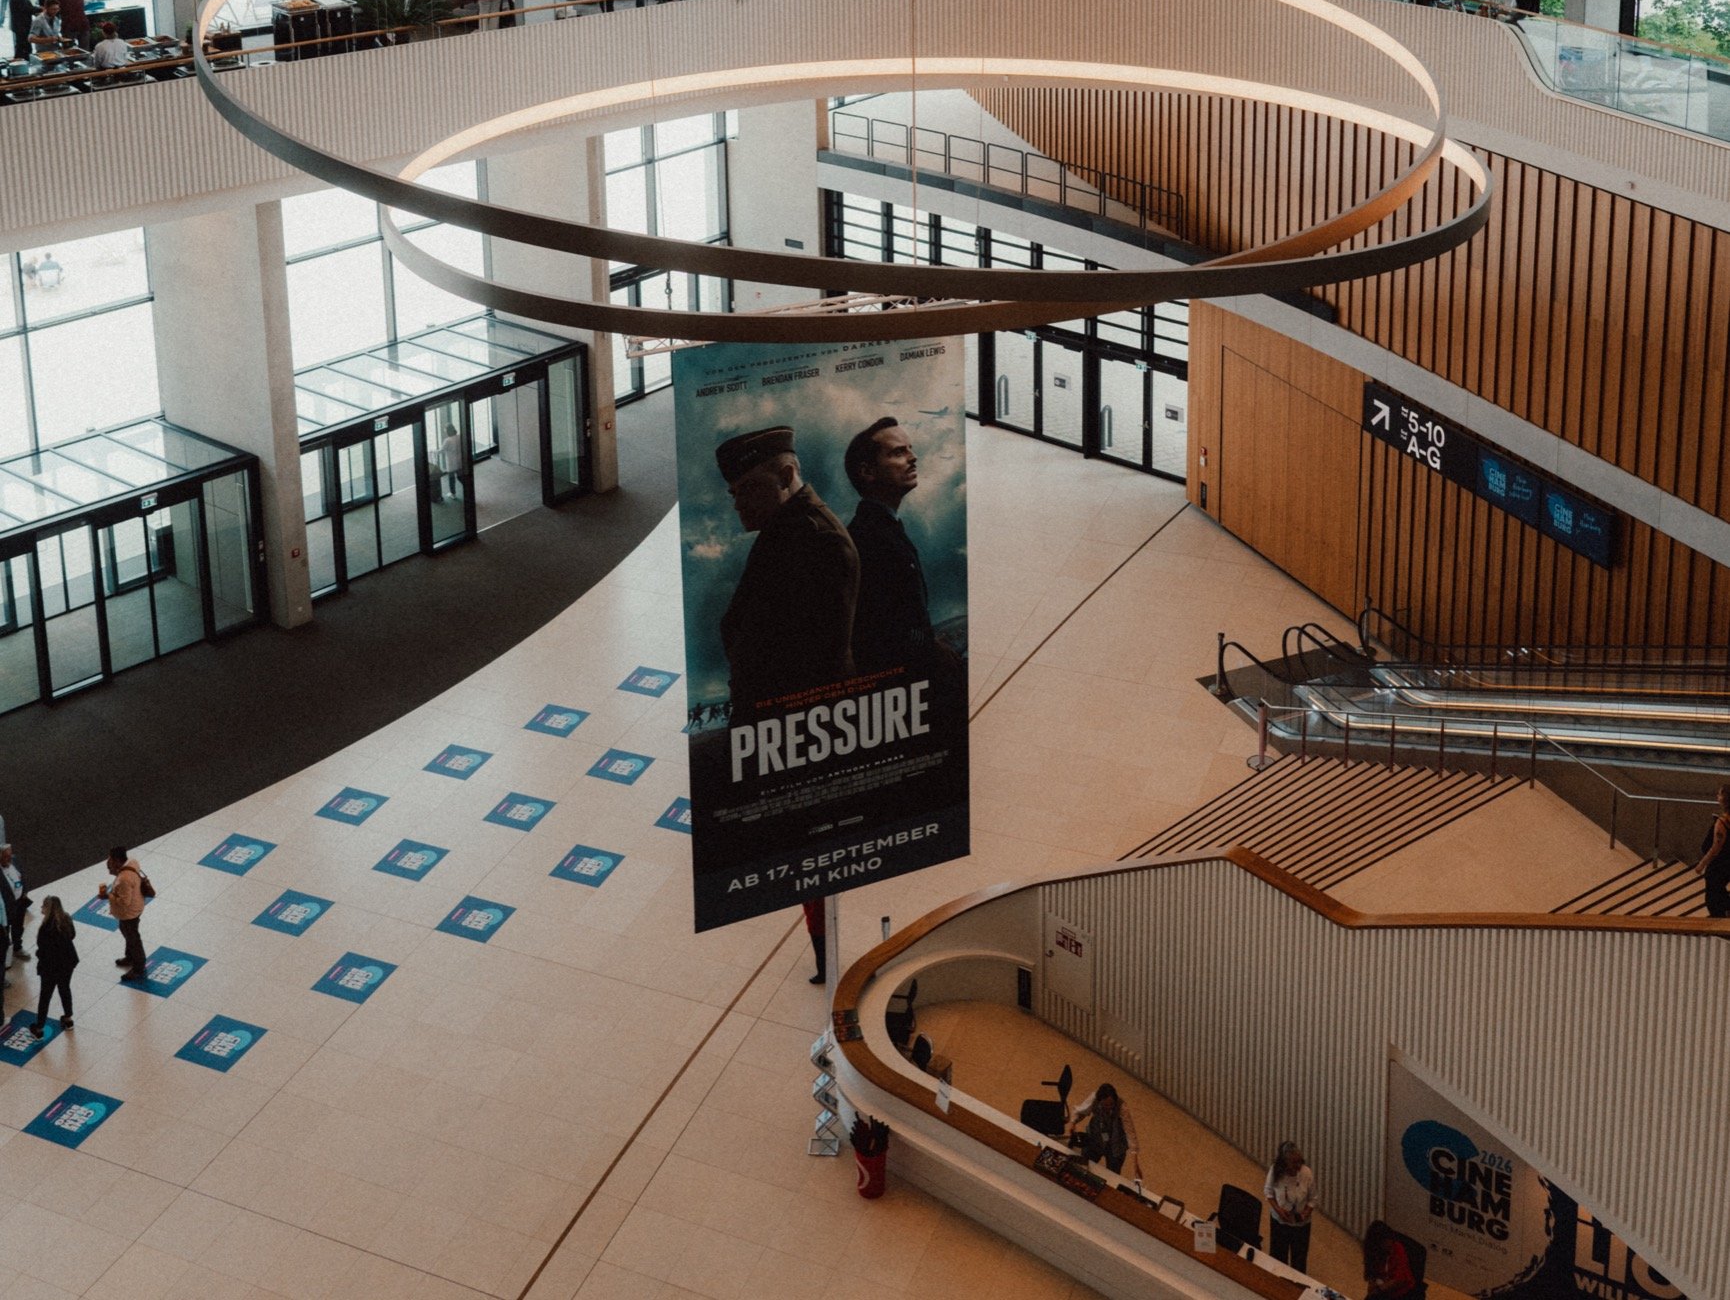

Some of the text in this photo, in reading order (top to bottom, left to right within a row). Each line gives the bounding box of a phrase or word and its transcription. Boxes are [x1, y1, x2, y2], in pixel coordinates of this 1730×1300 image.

[835, 361, 856, 373] KERRY
[857, 356, 884, 369] CONDON
[900, 350, 925, 362] DAMIAN
[925, 345, 946, 357] LEWIS
[696, 383, 725, 398] ANDREW
[726, 380, 748, 393] SCOTT
[761, 374, 793, 387] BRENDAN
[793, 368, 820, 380] FRASER
[1408, 411, 1445, 448] 5-10
[1407, 435, 1441, 470] A-G
[731, 680, 930, 783] PRESSURE
[727, 873, 760, 893] AB
[766, 864, 794, 881] 17.
[801, 822, 940, 872] SEPTEMBER
[795, 857, 883, 891] IM KINO
[1430, 1149, 1512, 1199] CINE
[1480, 1150, 1512, 1174] 2026
[1429, 1171, 1511, 1222] HAM
[1429, 1193, 1509, 1241] BURG
